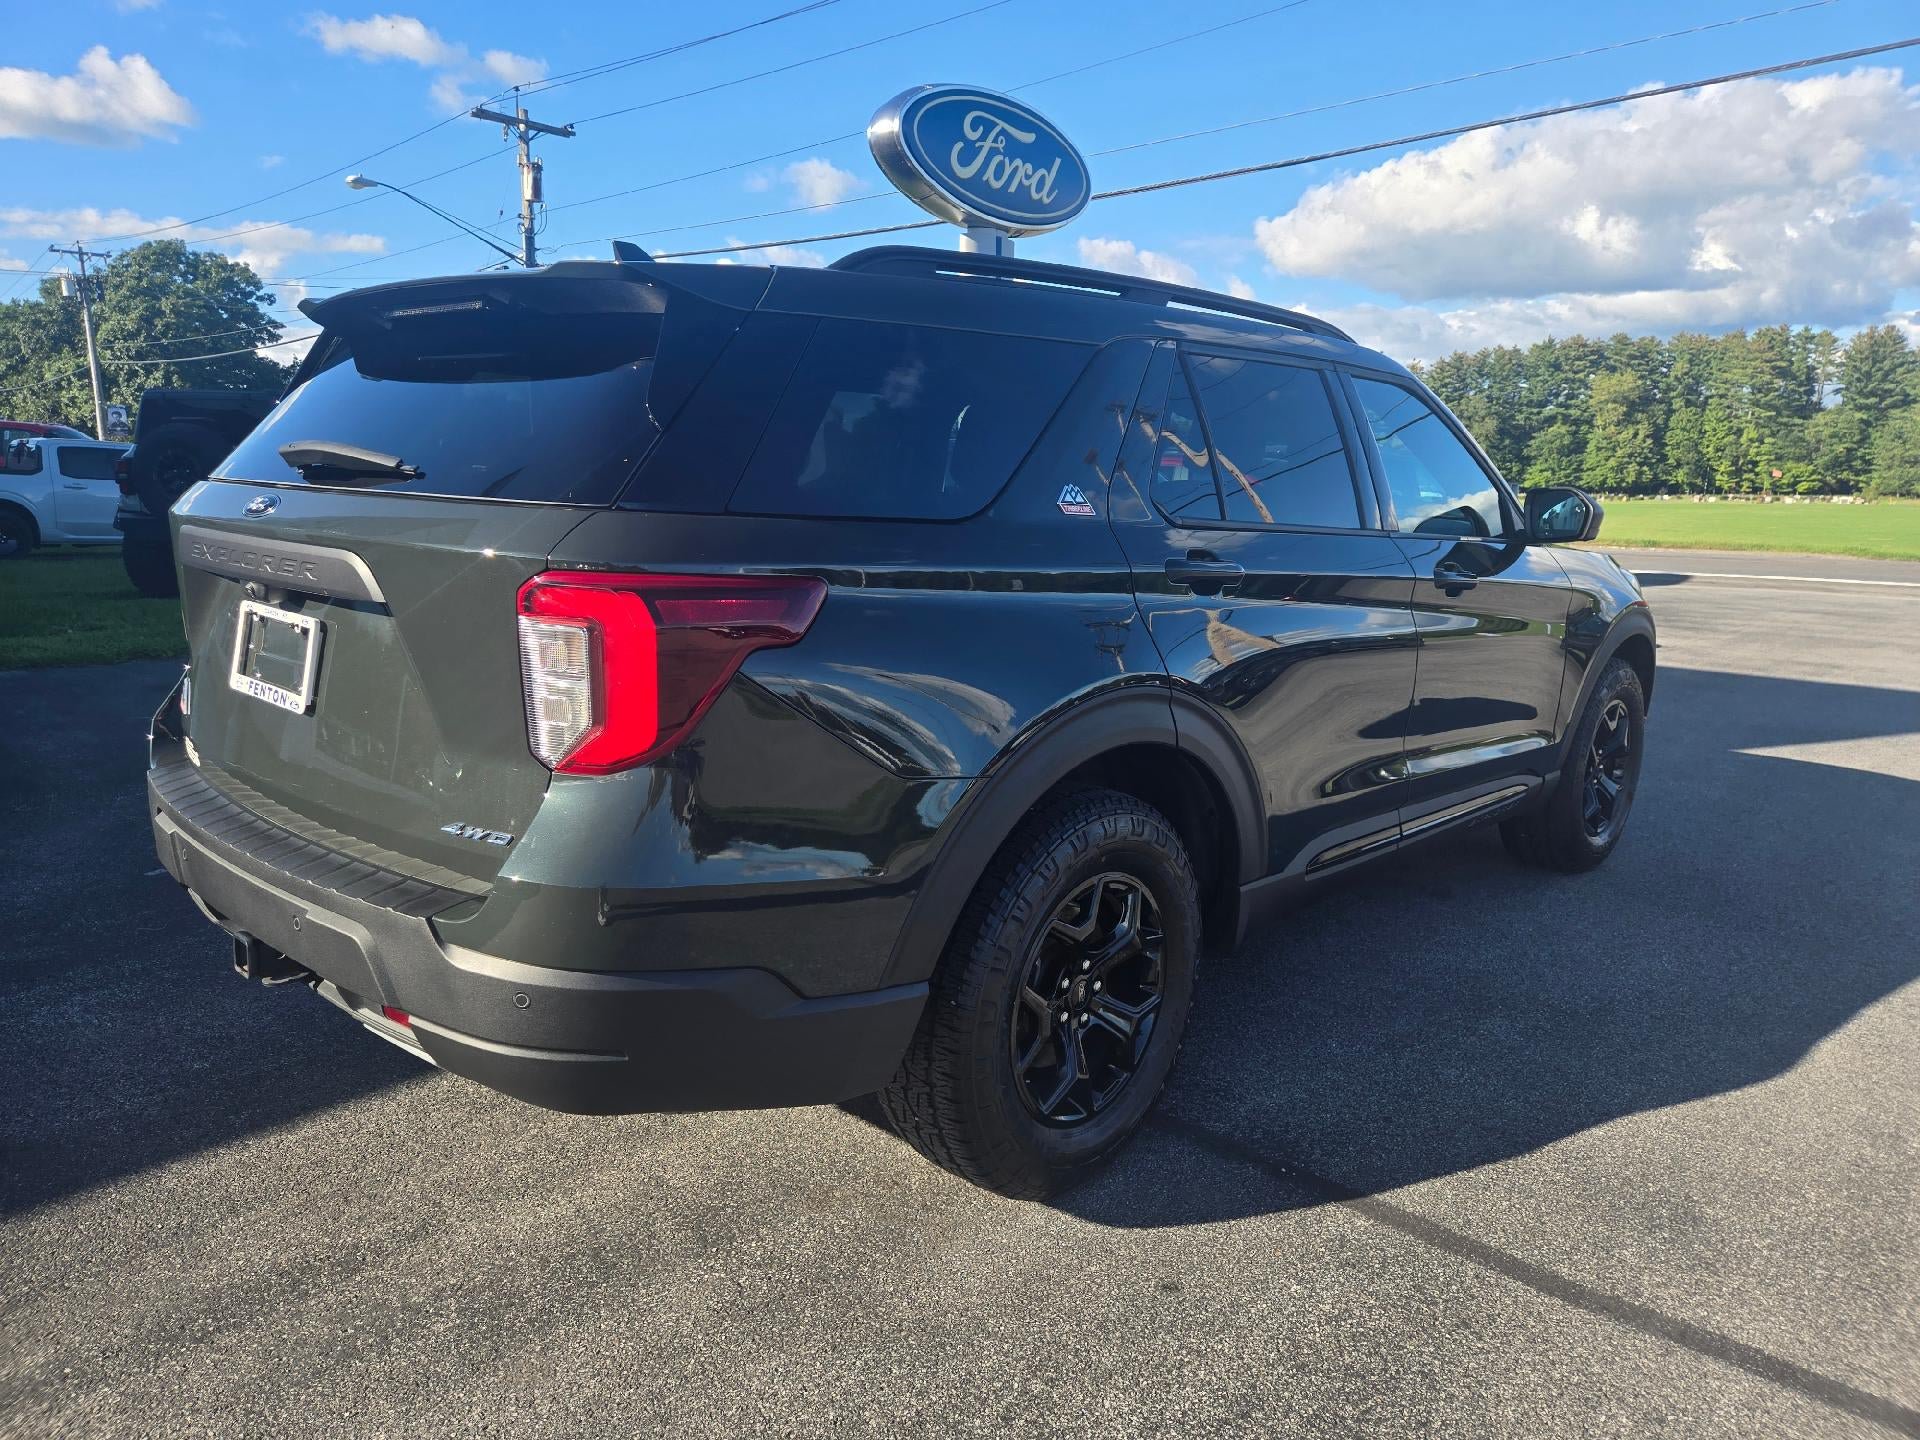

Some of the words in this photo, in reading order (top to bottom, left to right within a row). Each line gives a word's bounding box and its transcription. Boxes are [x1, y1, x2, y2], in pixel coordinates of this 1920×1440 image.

[951, 110, 1062, 205] Ford
[191, 540, 319, 581] EXPLORER
[440, 822, 515, 848] 4WD
